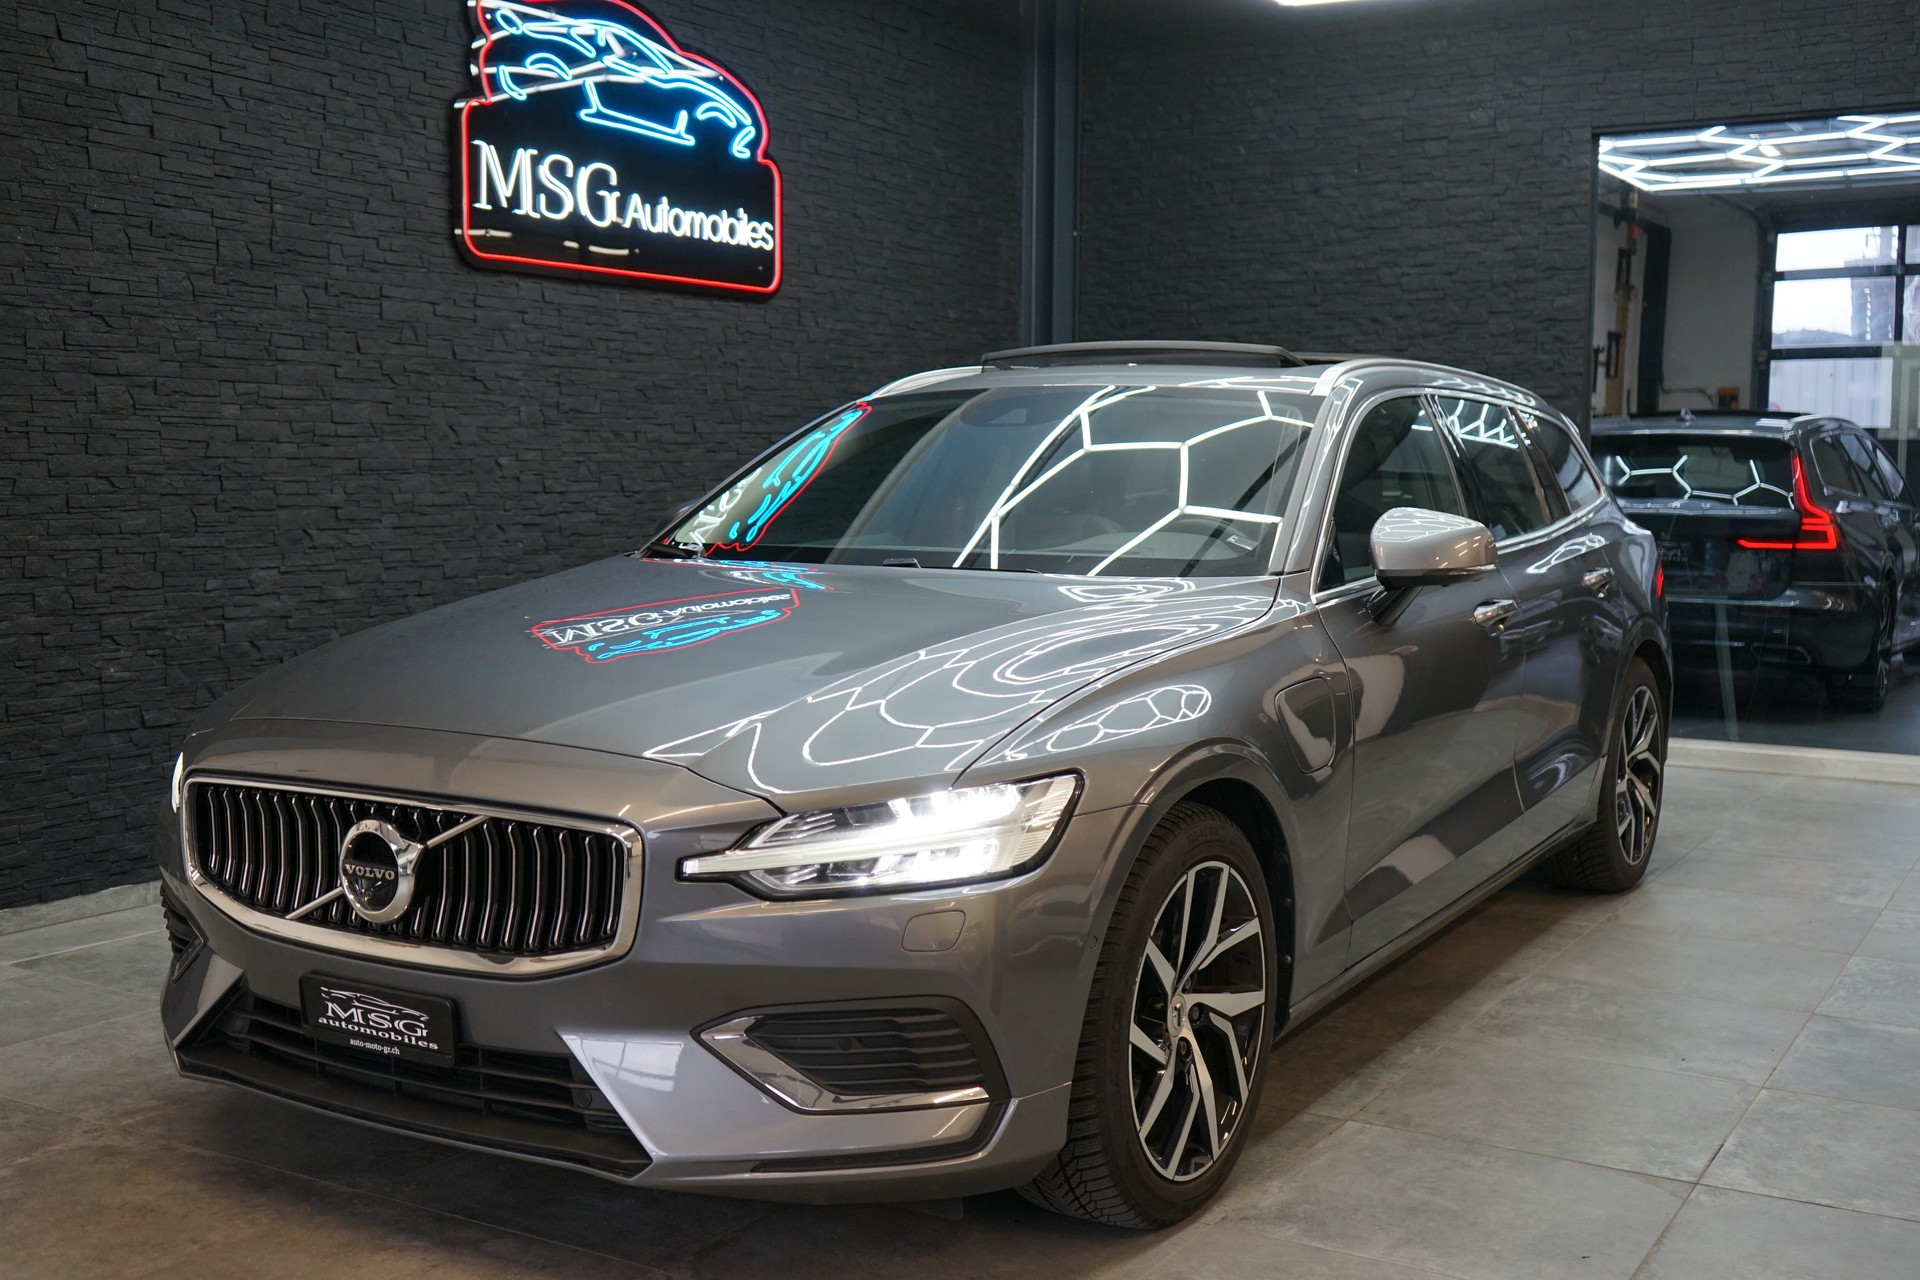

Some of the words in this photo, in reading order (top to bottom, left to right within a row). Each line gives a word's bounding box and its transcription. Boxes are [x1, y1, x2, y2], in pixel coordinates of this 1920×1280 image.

[471, 140, 621, 228] MSG
[621, 193, 774, 251] Automobiles
[344, 863, 395, 880] VOLVO
[318, 1016, 439, 1050] automobiles
[324, 1001, 429, 1037] MSG
[349, 1038, 400, 1055] auto-moto-gr.ch
